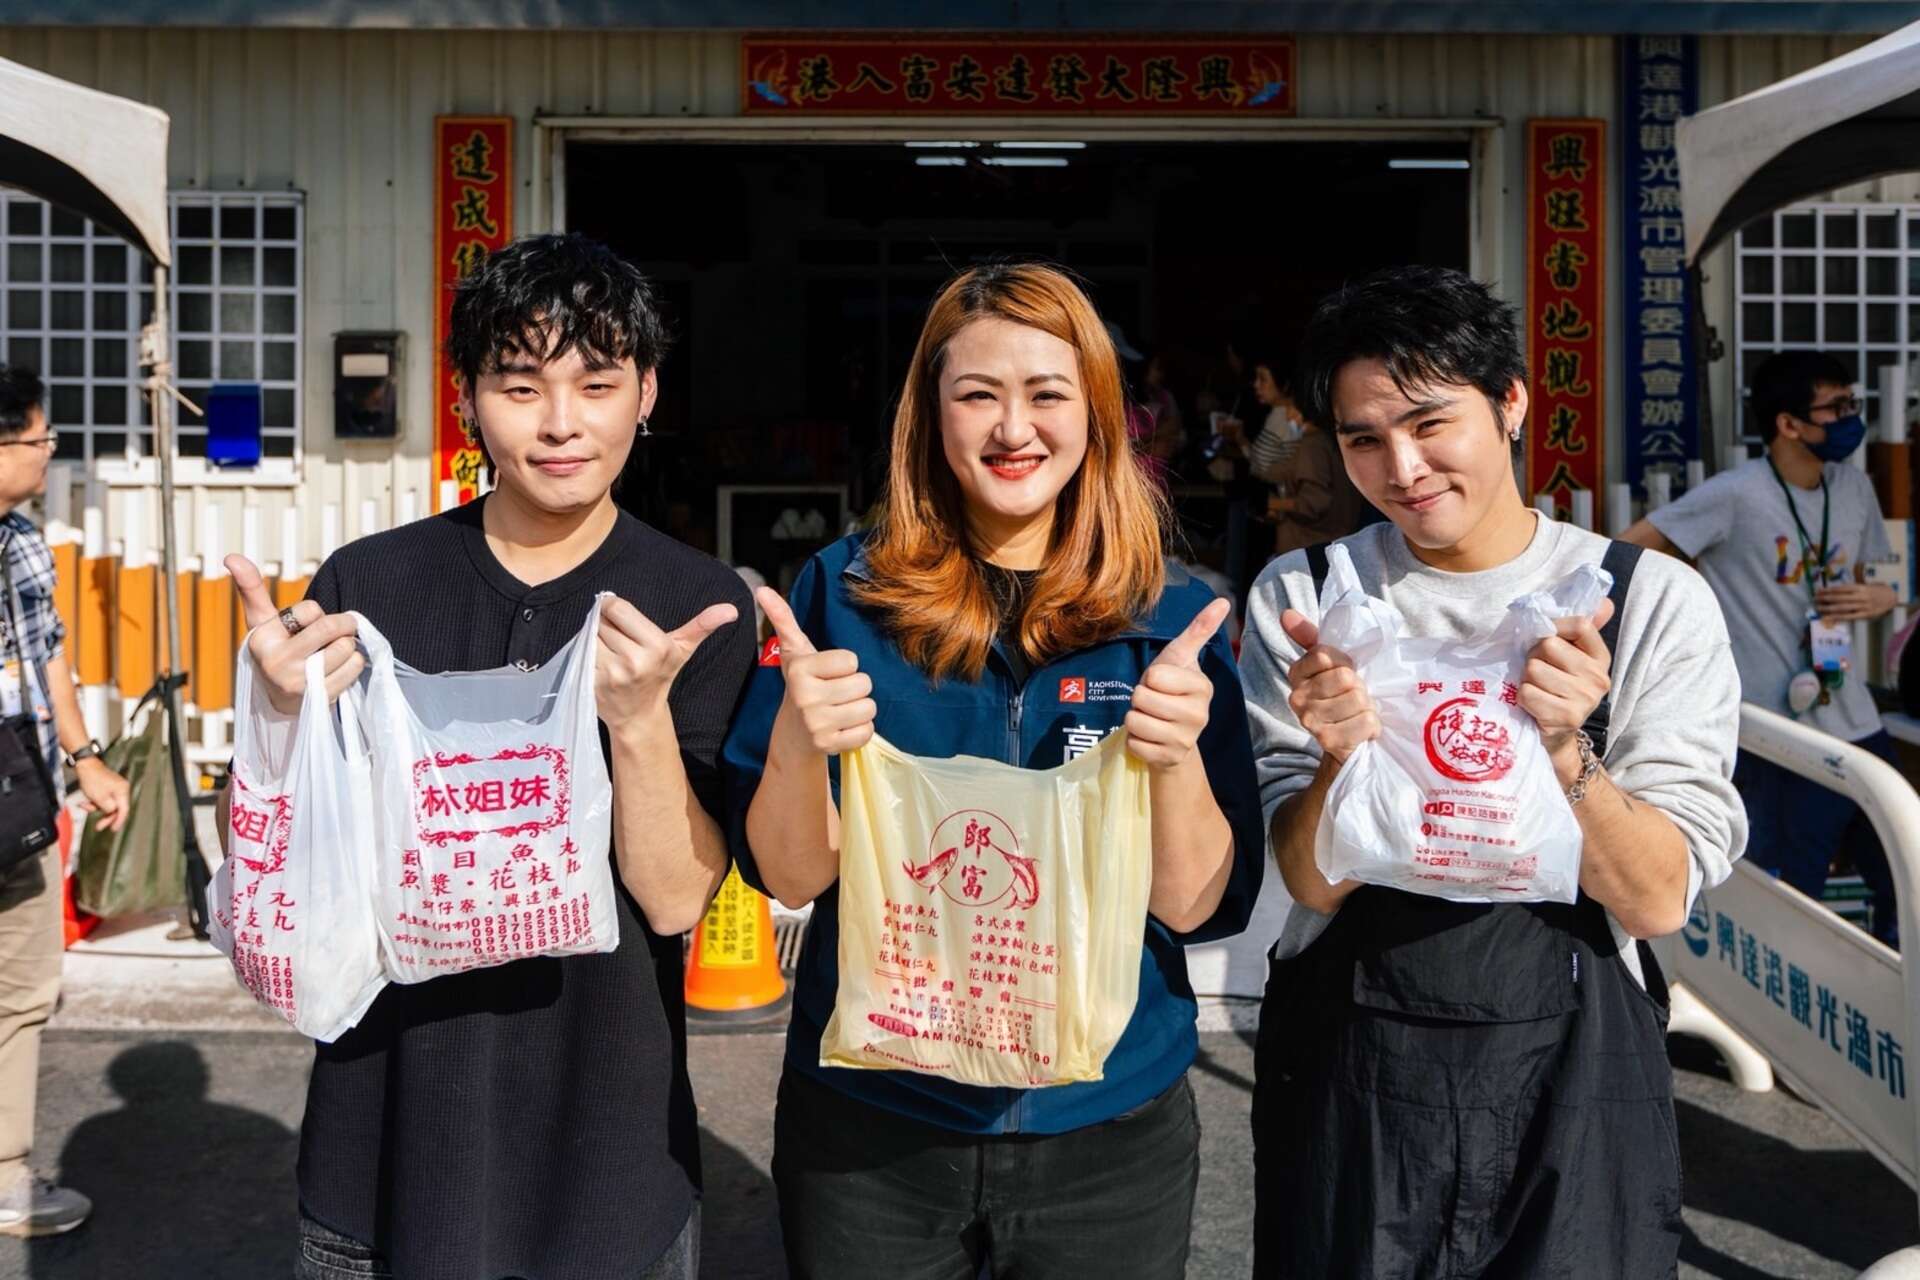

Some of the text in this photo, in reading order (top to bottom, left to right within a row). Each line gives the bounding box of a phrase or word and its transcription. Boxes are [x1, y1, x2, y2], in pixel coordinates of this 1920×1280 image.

[1541, 132, 1593, 521] 興旺當地觀光人
[421, 775, 552, 818] 林姐妹
[1715, 911, 1906, 1100] 興達港觀光漁市
